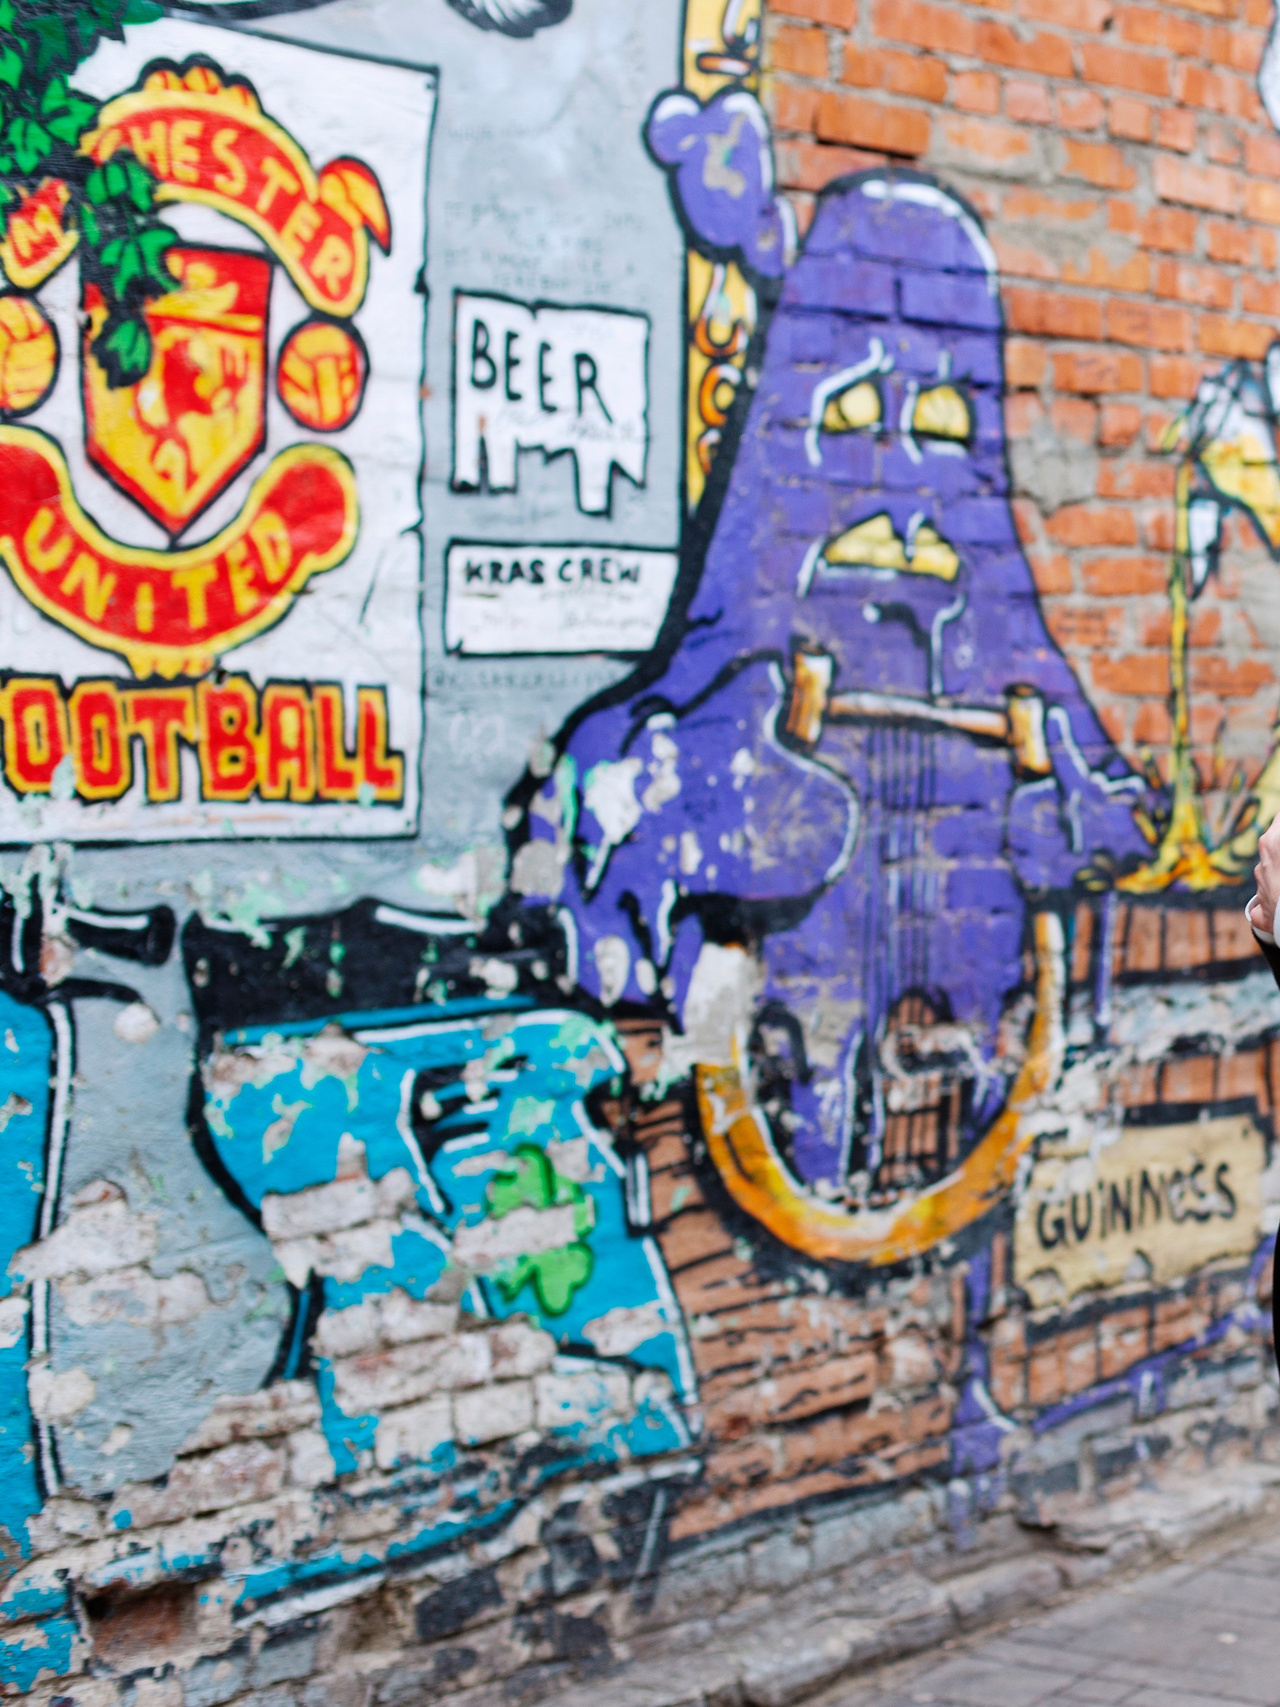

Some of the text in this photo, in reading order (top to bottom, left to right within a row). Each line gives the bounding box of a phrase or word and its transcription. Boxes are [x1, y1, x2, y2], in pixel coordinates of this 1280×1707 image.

[470, 318, 614, 425] BEER
[23, 506, 292, 633] UNITED
[465, 557, 640, 584] KRAS CREW
[0, 674, 404, 804] OOTBALL
[1036, 1162, 1237, 1250] GUINNESS
